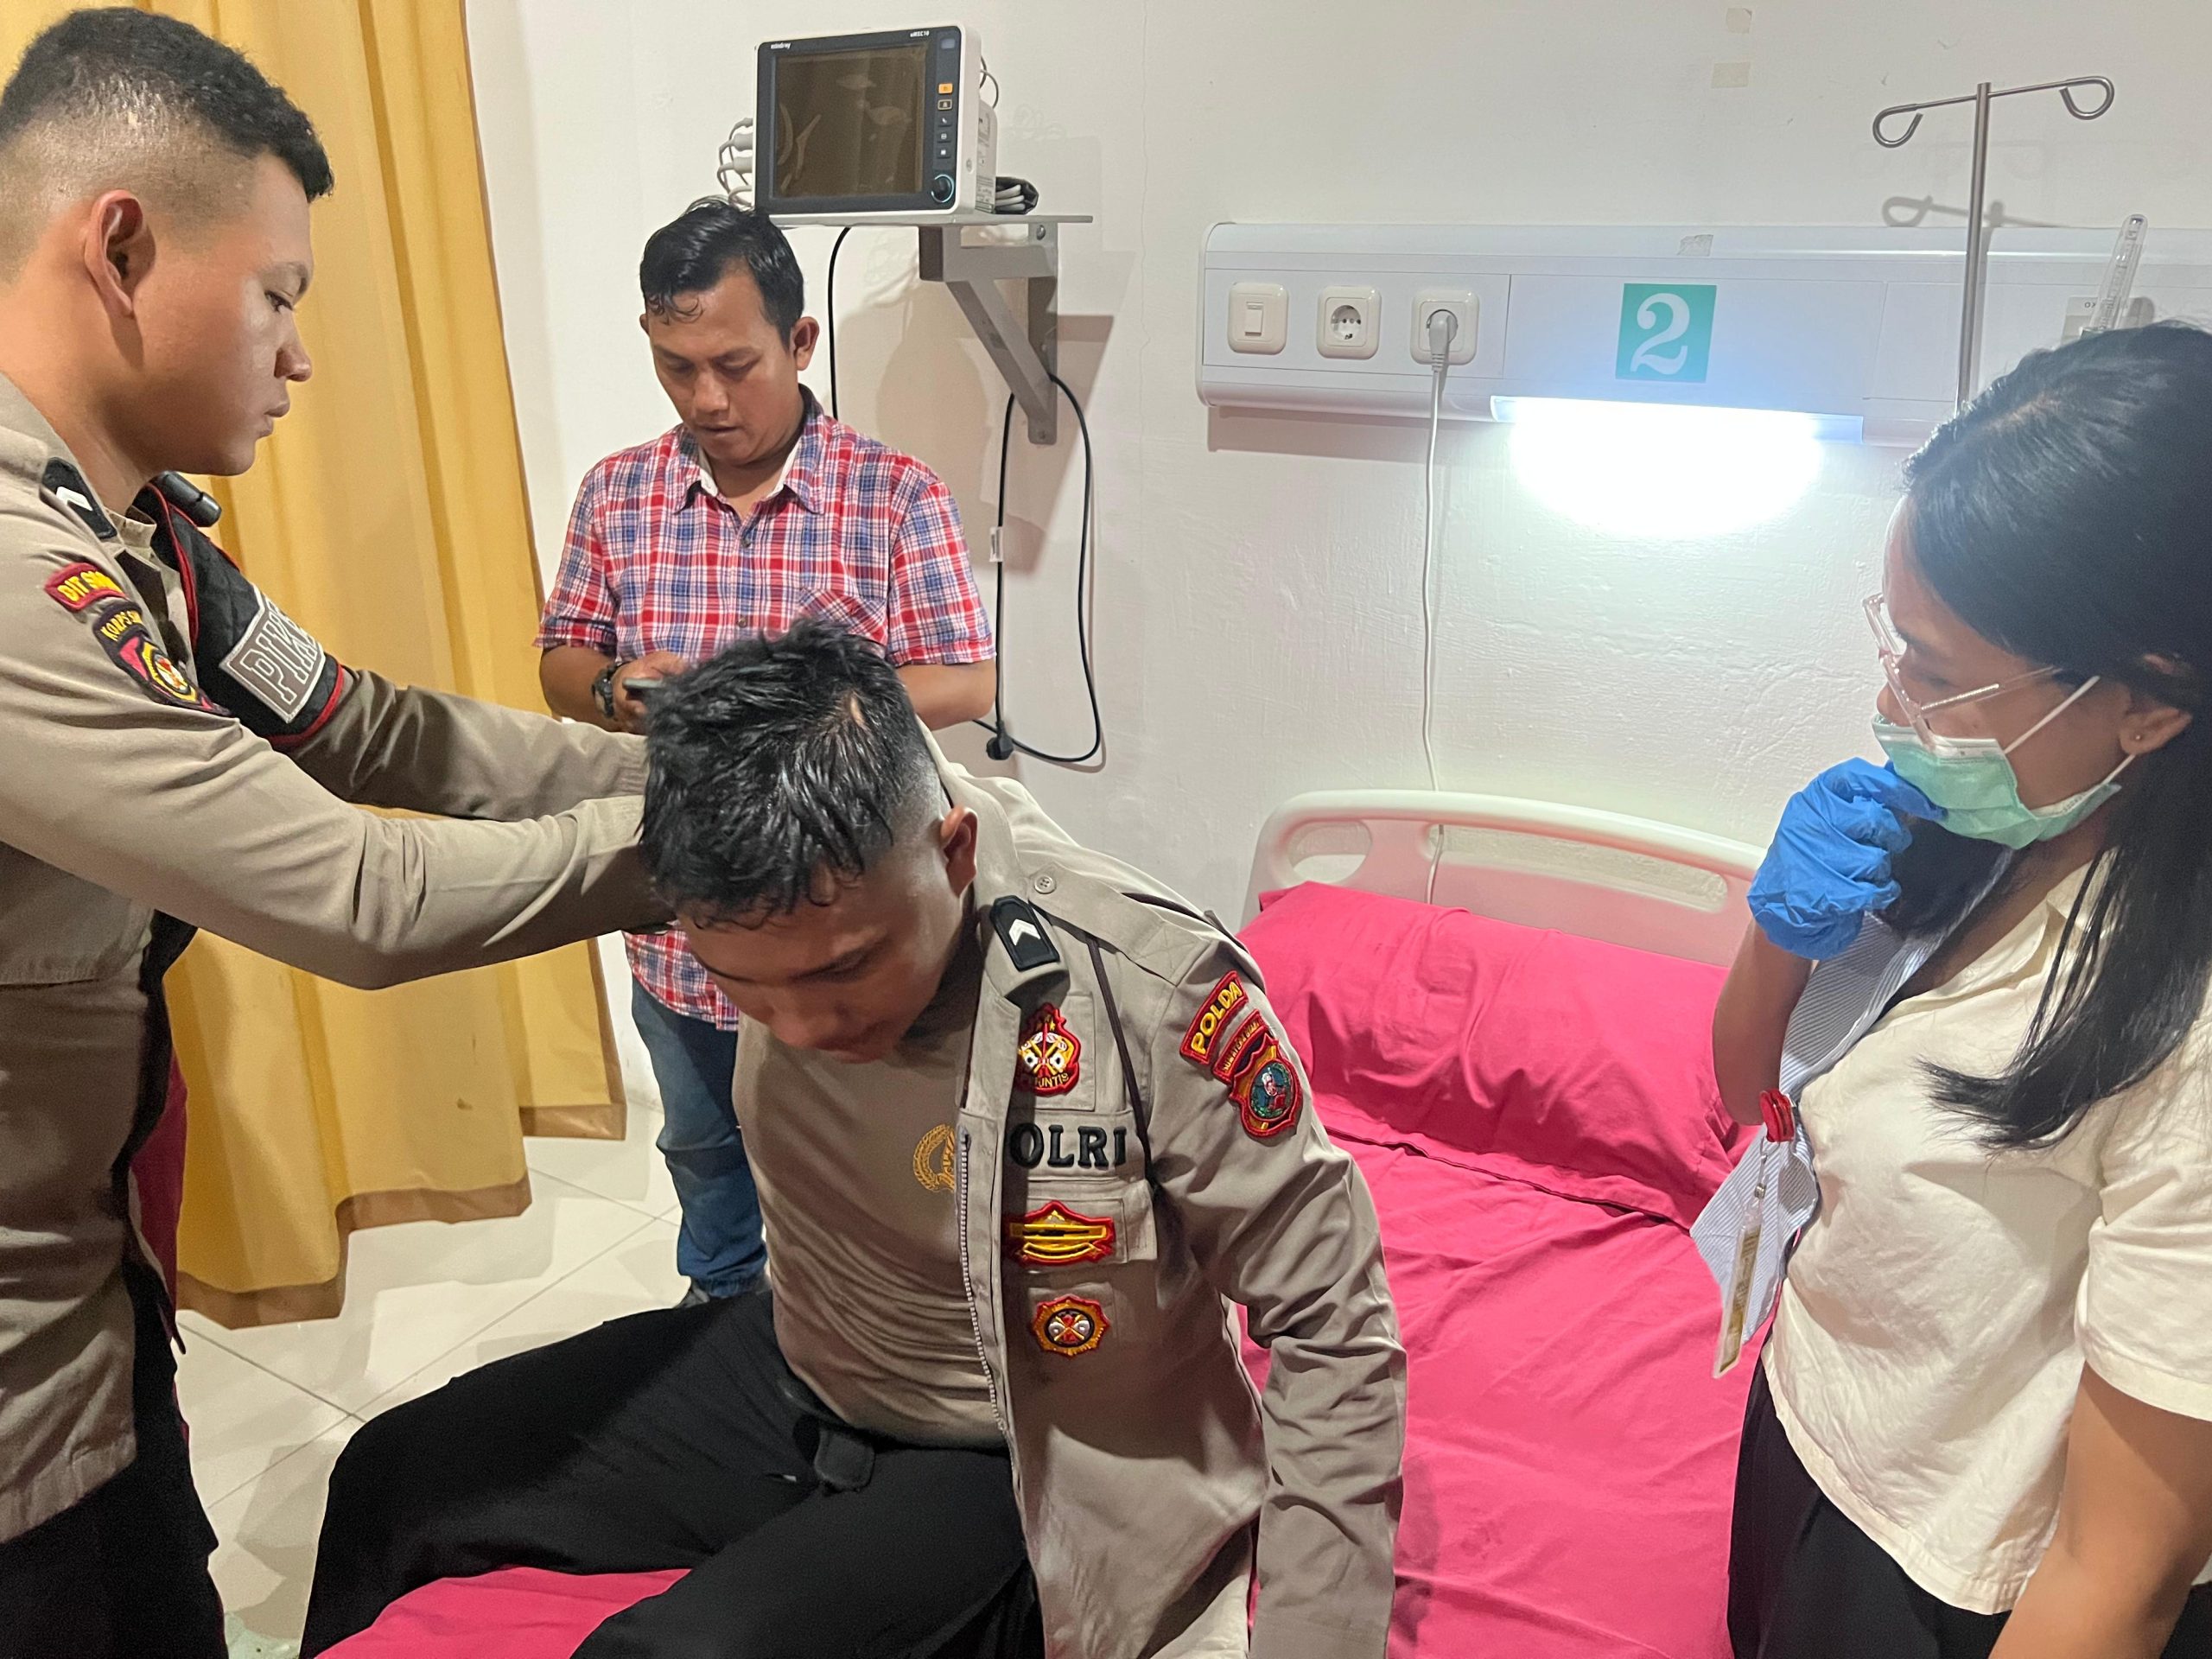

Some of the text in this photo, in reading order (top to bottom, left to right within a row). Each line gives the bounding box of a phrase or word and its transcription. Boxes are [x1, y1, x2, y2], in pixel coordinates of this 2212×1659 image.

[1630, 292, 1691, 375] 2
[1191, 982, 1243, 1054] POLDA
[1010, 1123, 1127, 1168] OLRI
